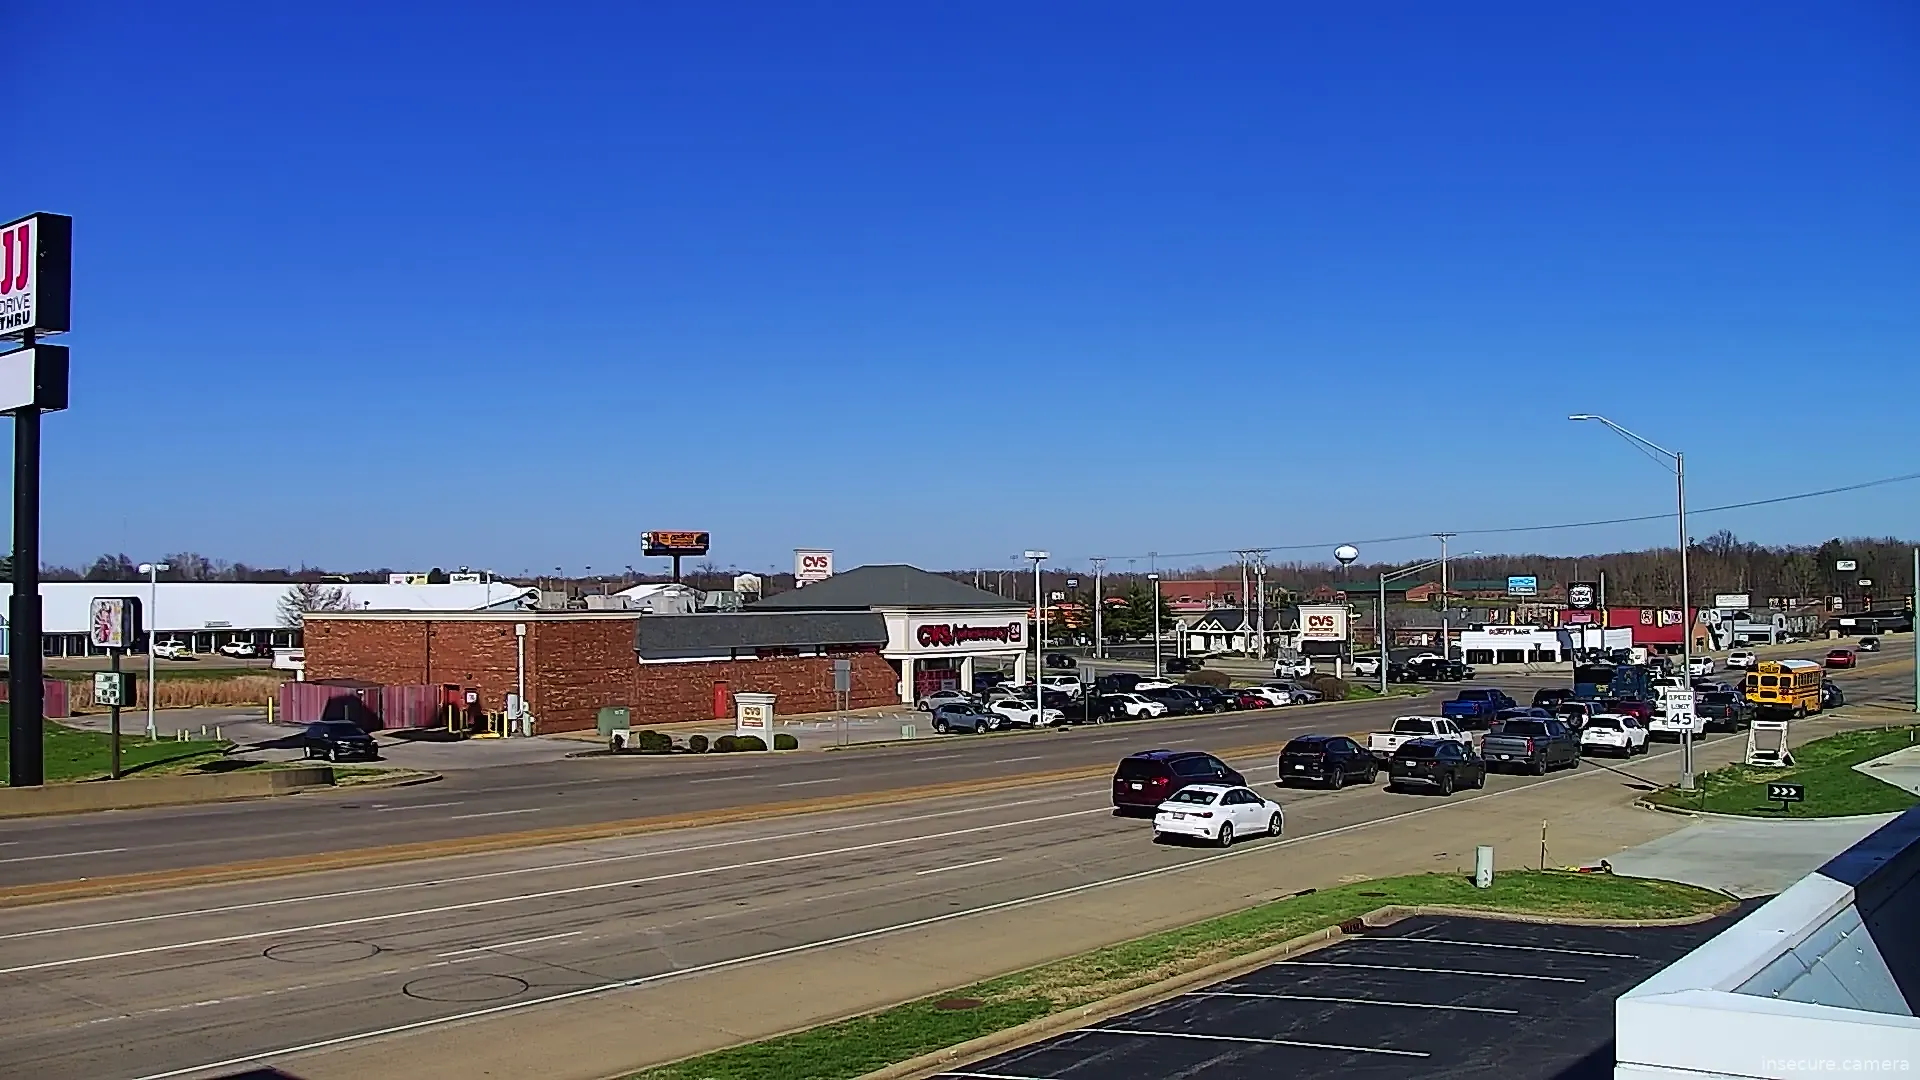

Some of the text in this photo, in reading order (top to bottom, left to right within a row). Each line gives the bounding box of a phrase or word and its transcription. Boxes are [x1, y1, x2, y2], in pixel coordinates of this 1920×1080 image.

[803, 556, 828, 568] CVS
[1309, 616, 1334, 627] CVS
[744, 707, 760, 716] CVS
[1670, 712, 1692, 725] 45
